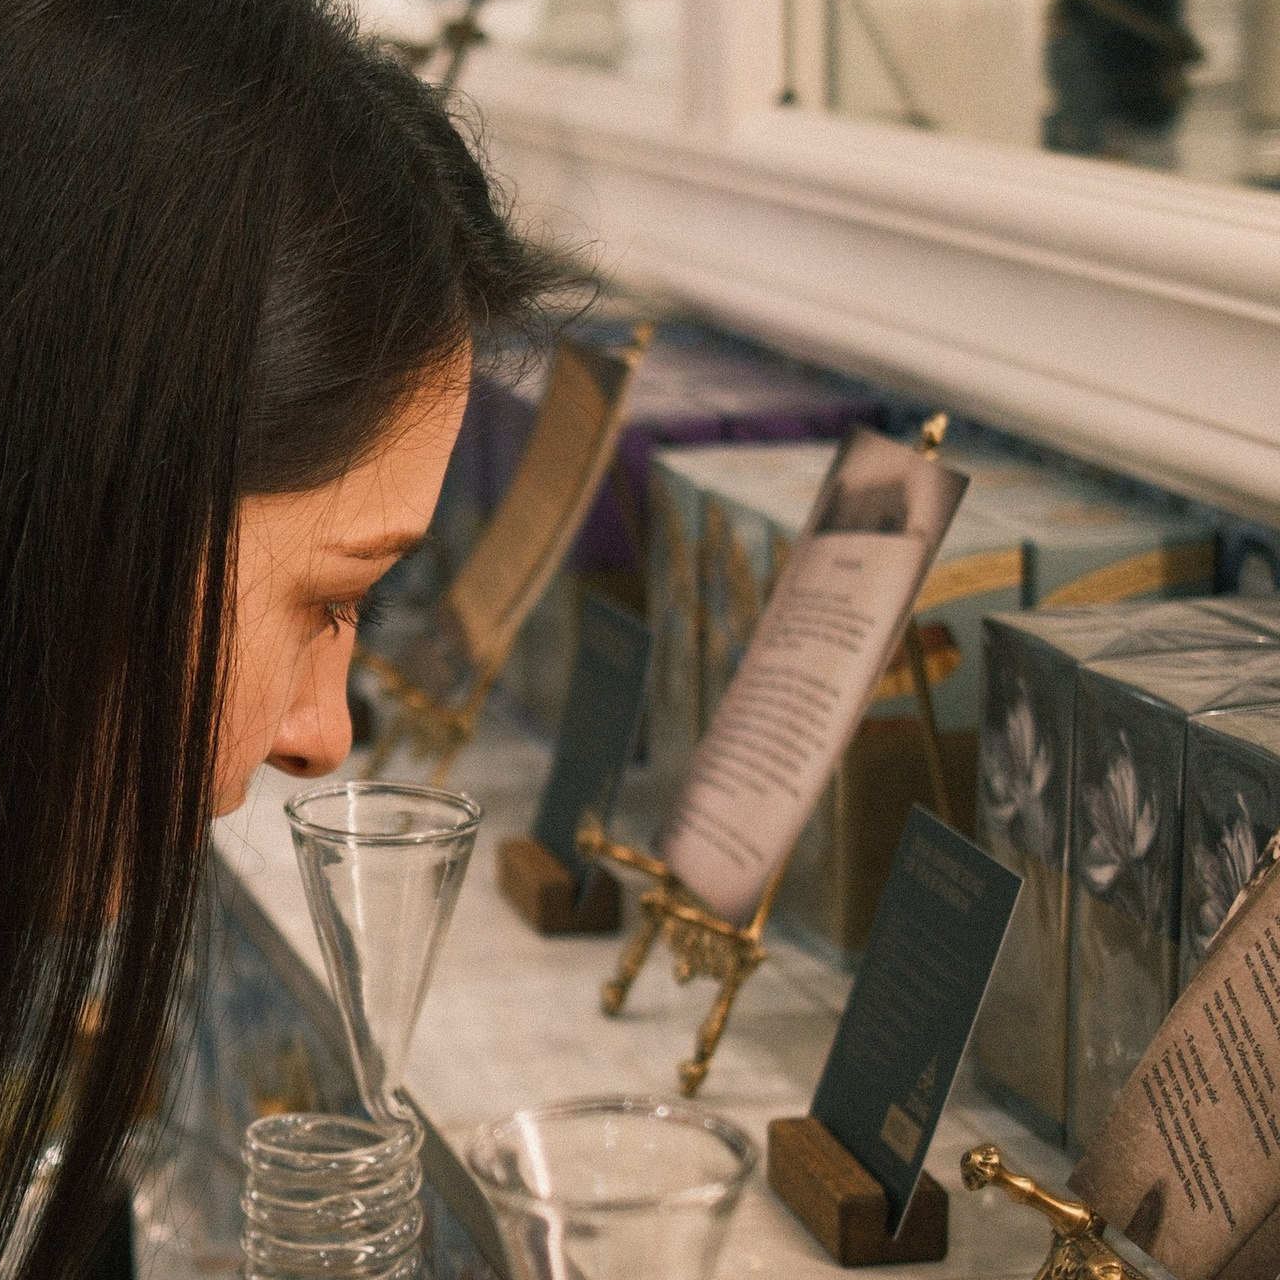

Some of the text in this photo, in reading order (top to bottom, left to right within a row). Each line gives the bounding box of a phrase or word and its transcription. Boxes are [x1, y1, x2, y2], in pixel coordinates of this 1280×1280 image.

[1203, 1003, 1217, 1027] силой
[1236, 1042, 1259, 1093] Собиралась
[1253, 1044, 1266, 1069] бобы
[1189, 1118, 1202, 1144] пахла
[1198, 1140, 1222, 1191] бурбонской
